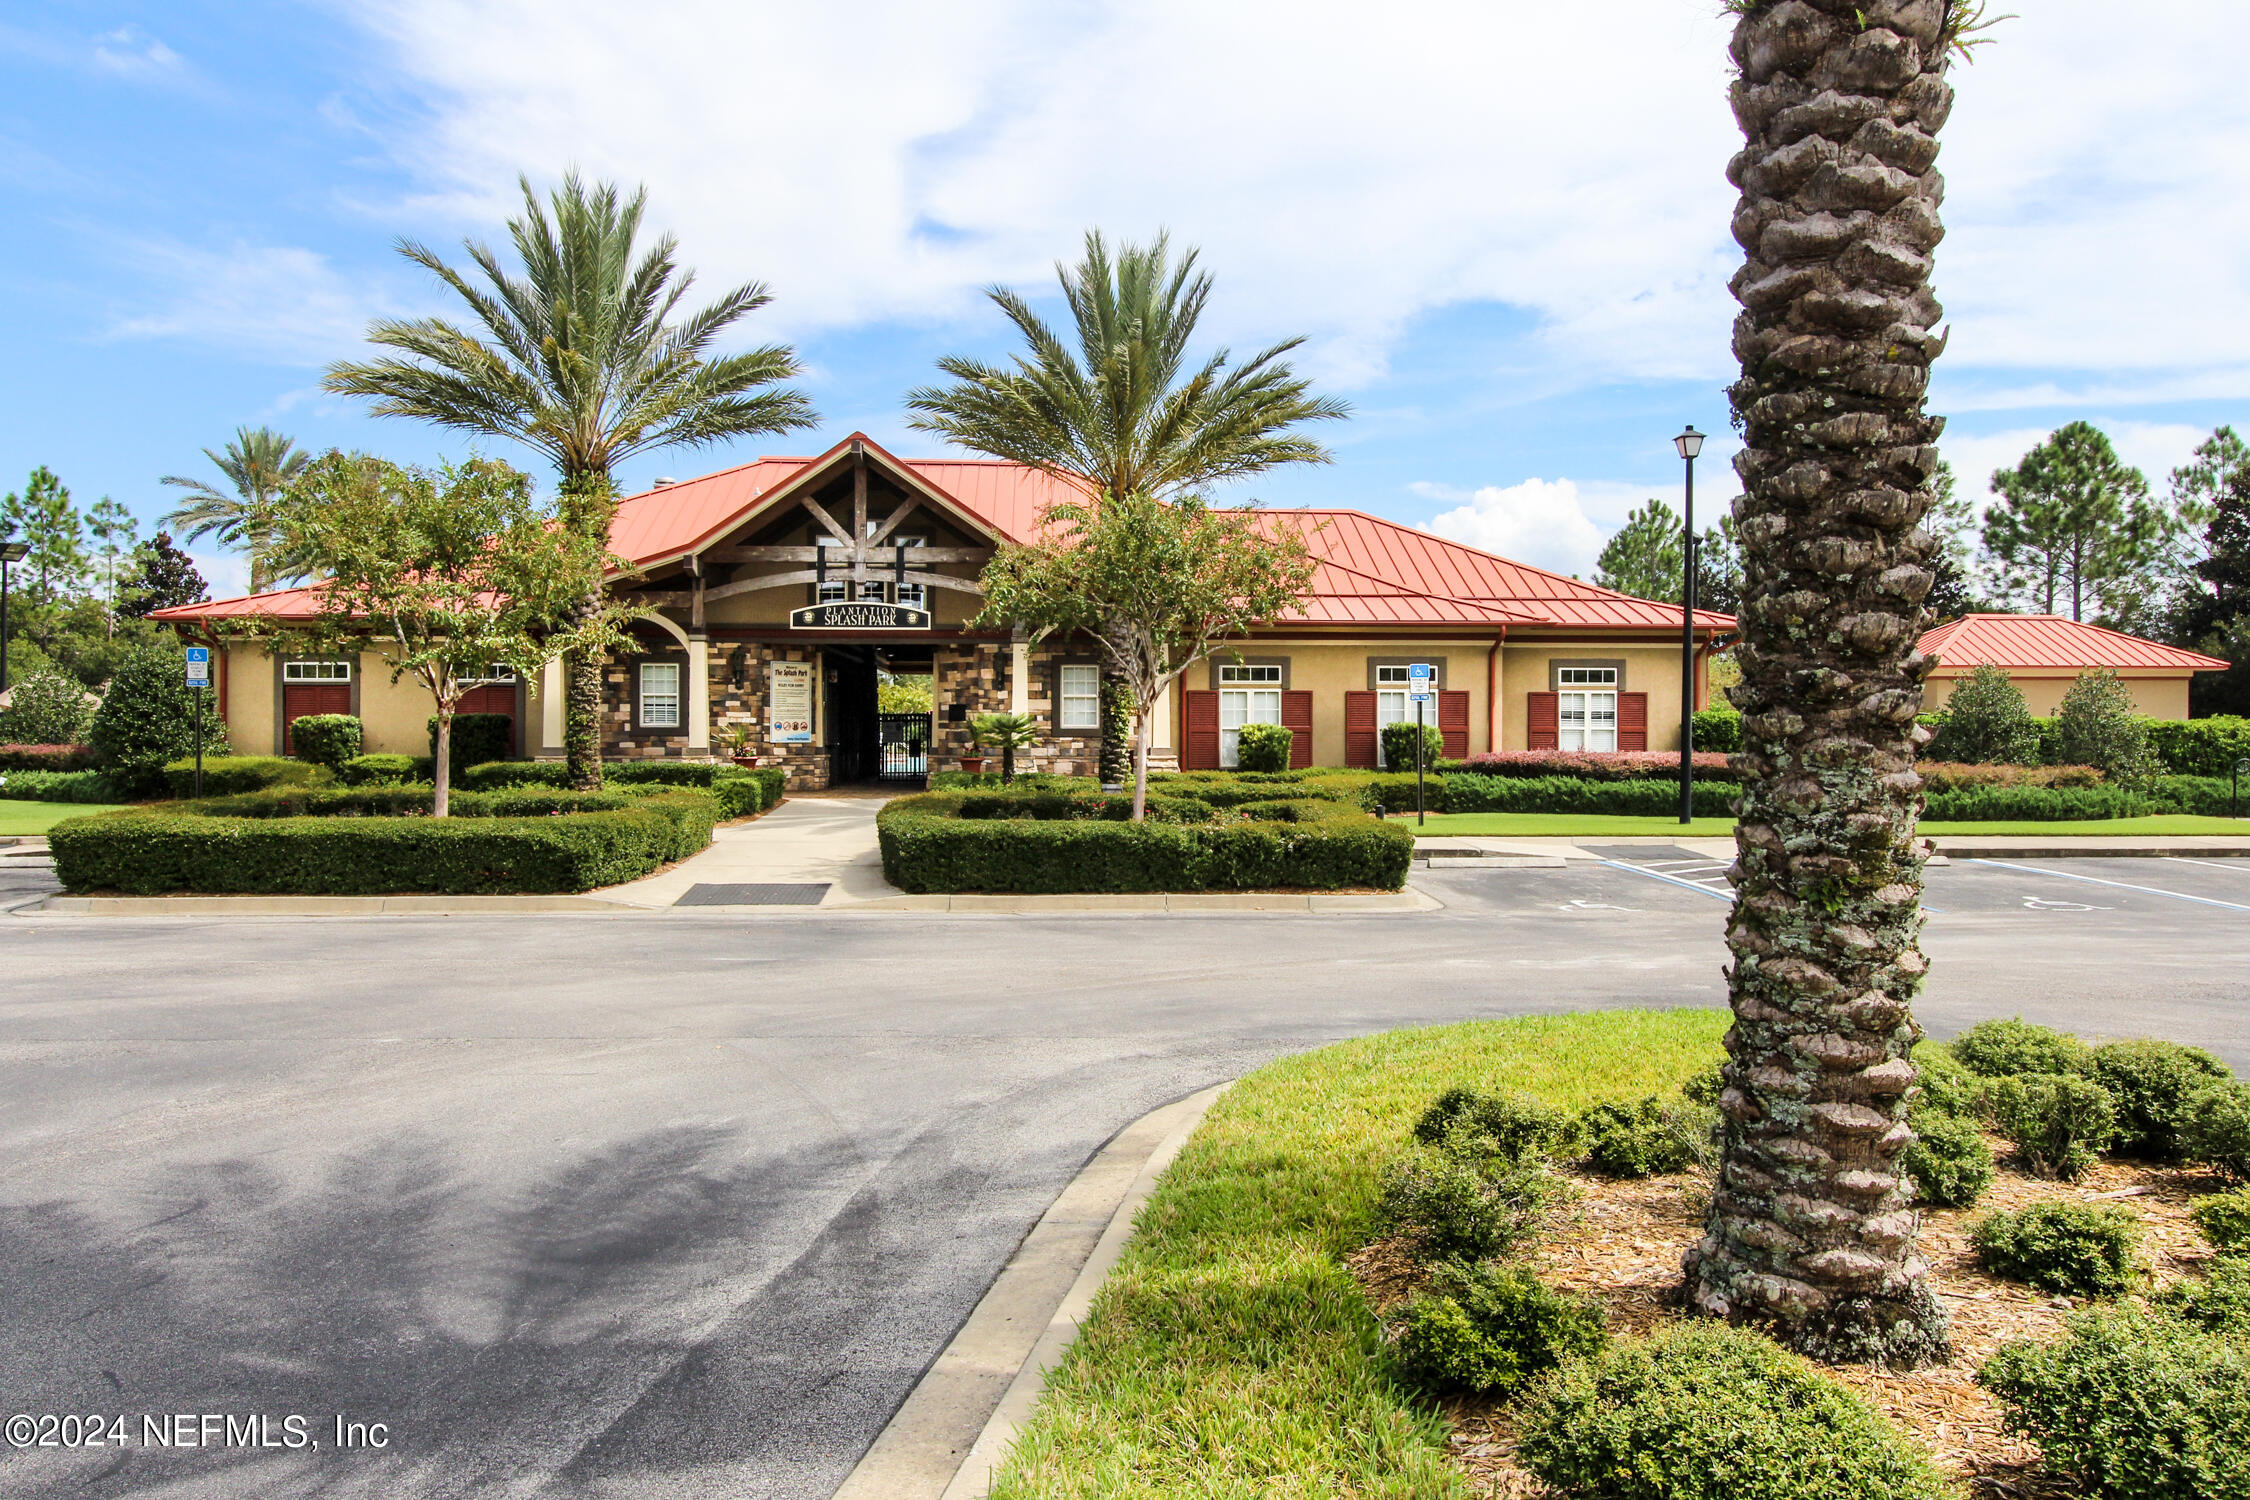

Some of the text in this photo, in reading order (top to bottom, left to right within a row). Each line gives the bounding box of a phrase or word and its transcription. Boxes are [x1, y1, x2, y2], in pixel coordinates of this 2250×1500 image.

[826, 607, 896, 615] PLANTATION
[824, 614, 897, 626] SPLASH PARK
[784, 669, 797, 677] Splash
[798, 669, 808, 677] Park
